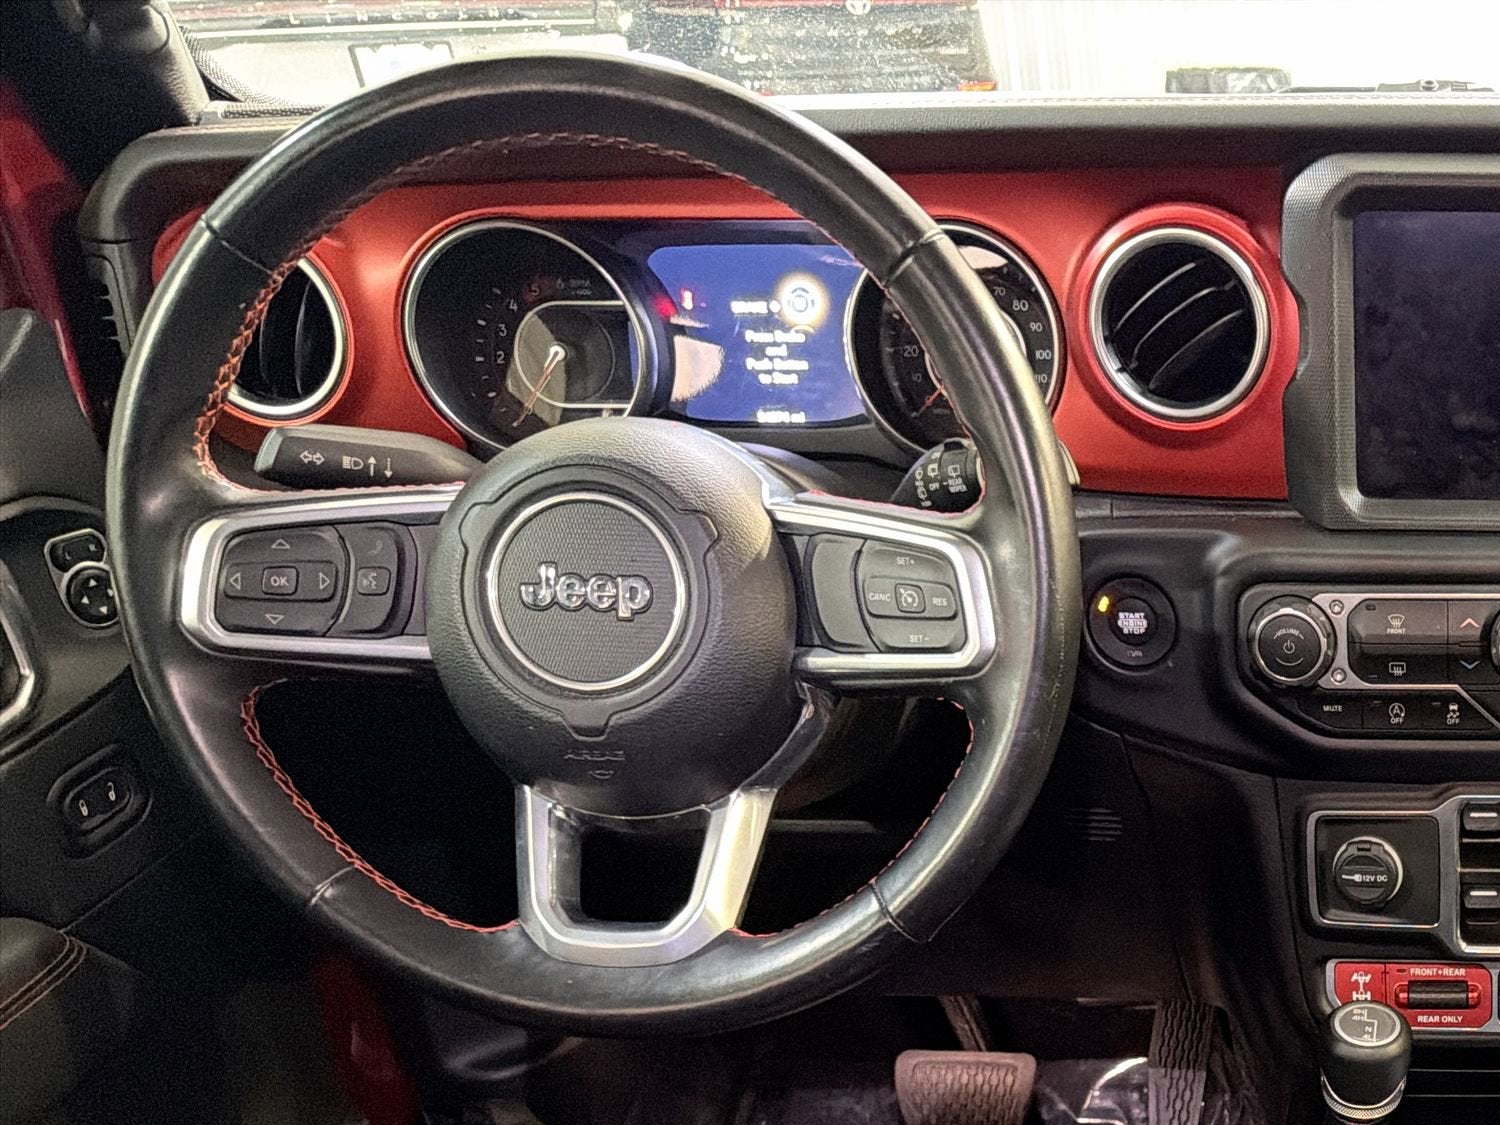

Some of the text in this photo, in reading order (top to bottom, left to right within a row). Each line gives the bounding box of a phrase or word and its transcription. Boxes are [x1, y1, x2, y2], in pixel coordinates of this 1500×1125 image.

[993, 286, 1006, 296] 70
[509, 299, 519, 312] 4
[1012, 299, 1029, 312] 80
[499, 324, 507, 337] 3
[1029, 322, 1043, 332] 90
[903, 345, 919, 358] 20
[1035, 349, 1052, 360] 100
[496, 351, 505, 364] 2
[270, 575, 289, 587] OK
[520, 561, 653, 621] Jeep
[868, 592, 891, 602] CANC
[932, 597, 947, 607] RES
[1386, 627, 1406, 635] FRONT
[1323, 704, 1342, 712] MUTE
[1390, 717, 1405, 725] OFF
[1446, 717, 1460, 725] OFF
[1362, 874, 1388, 882] 12V DC
[1417, 1015, 1463, 1023] REAR ONLY
